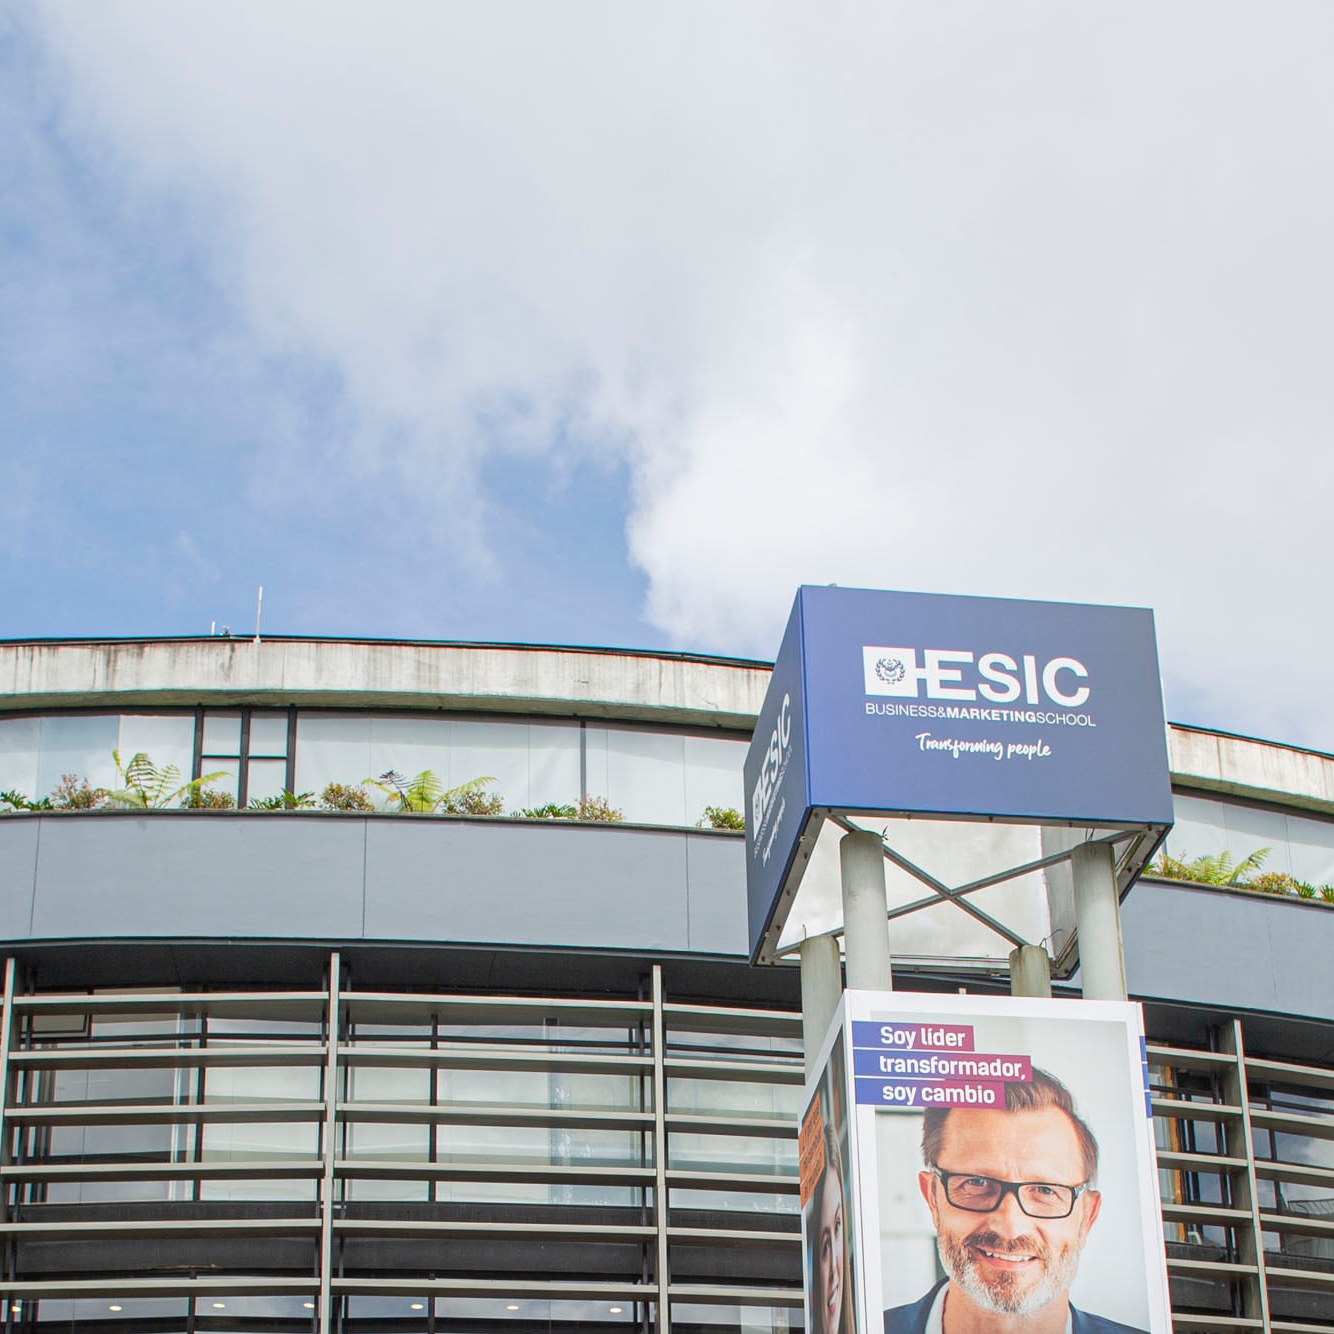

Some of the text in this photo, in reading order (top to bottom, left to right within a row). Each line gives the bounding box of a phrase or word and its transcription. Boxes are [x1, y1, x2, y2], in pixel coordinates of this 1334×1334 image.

[924, 648, 1091, 708] ESIC
[865, 702, 1097, 728] BUSINESS&MARKETINGSCHOOL
[915, 732, 1052, 762] Transforming people
[880, 1026, 966, 1049] Soy líder
[879, 1055, 1027, 1081] transformador,
[882, 1083, 996, 1105] soy cambio
